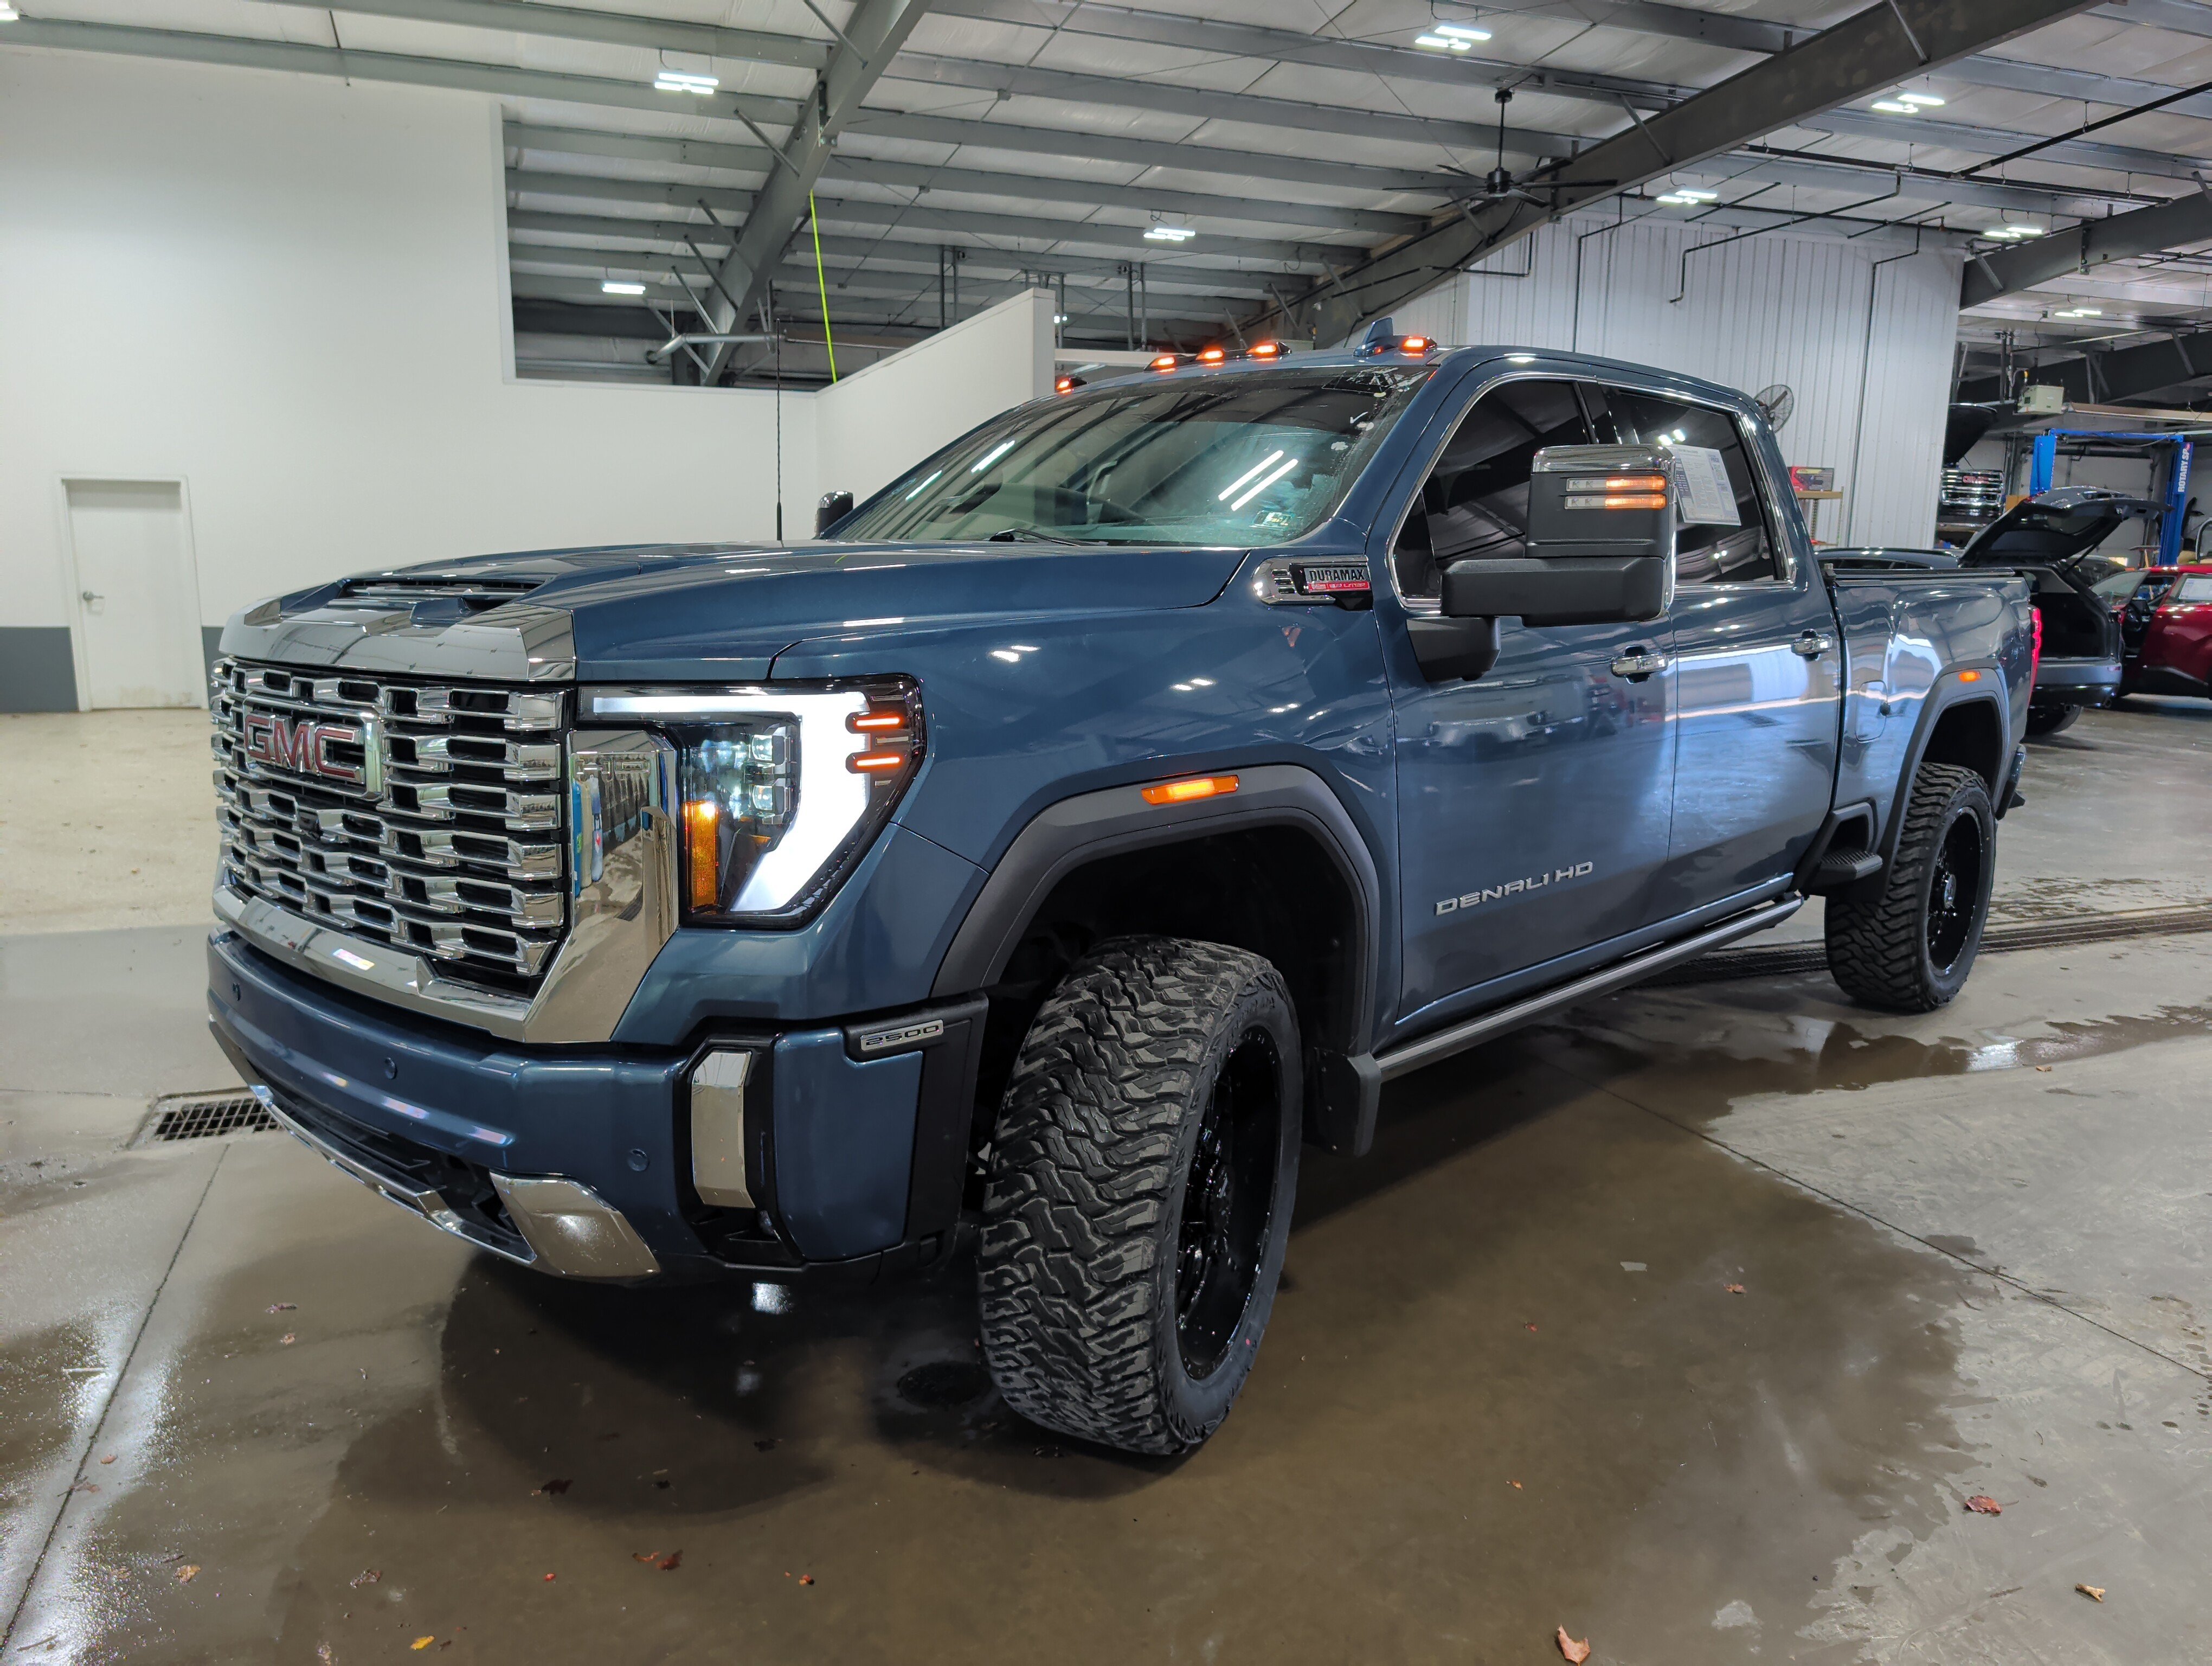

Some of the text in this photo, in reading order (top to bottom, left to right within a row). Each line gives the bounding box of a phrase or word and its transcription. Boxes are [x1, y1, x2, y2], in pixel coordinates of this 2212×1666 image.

[2177, 460, 2189, 492] ROTARY
[1309, 569, 1365, 581] DURAMAX
[245, 713, 361, 781] GMC
[1436, 861, 1593, 915] DENALI HD
[866, 1024, 940, 1046] 2500
